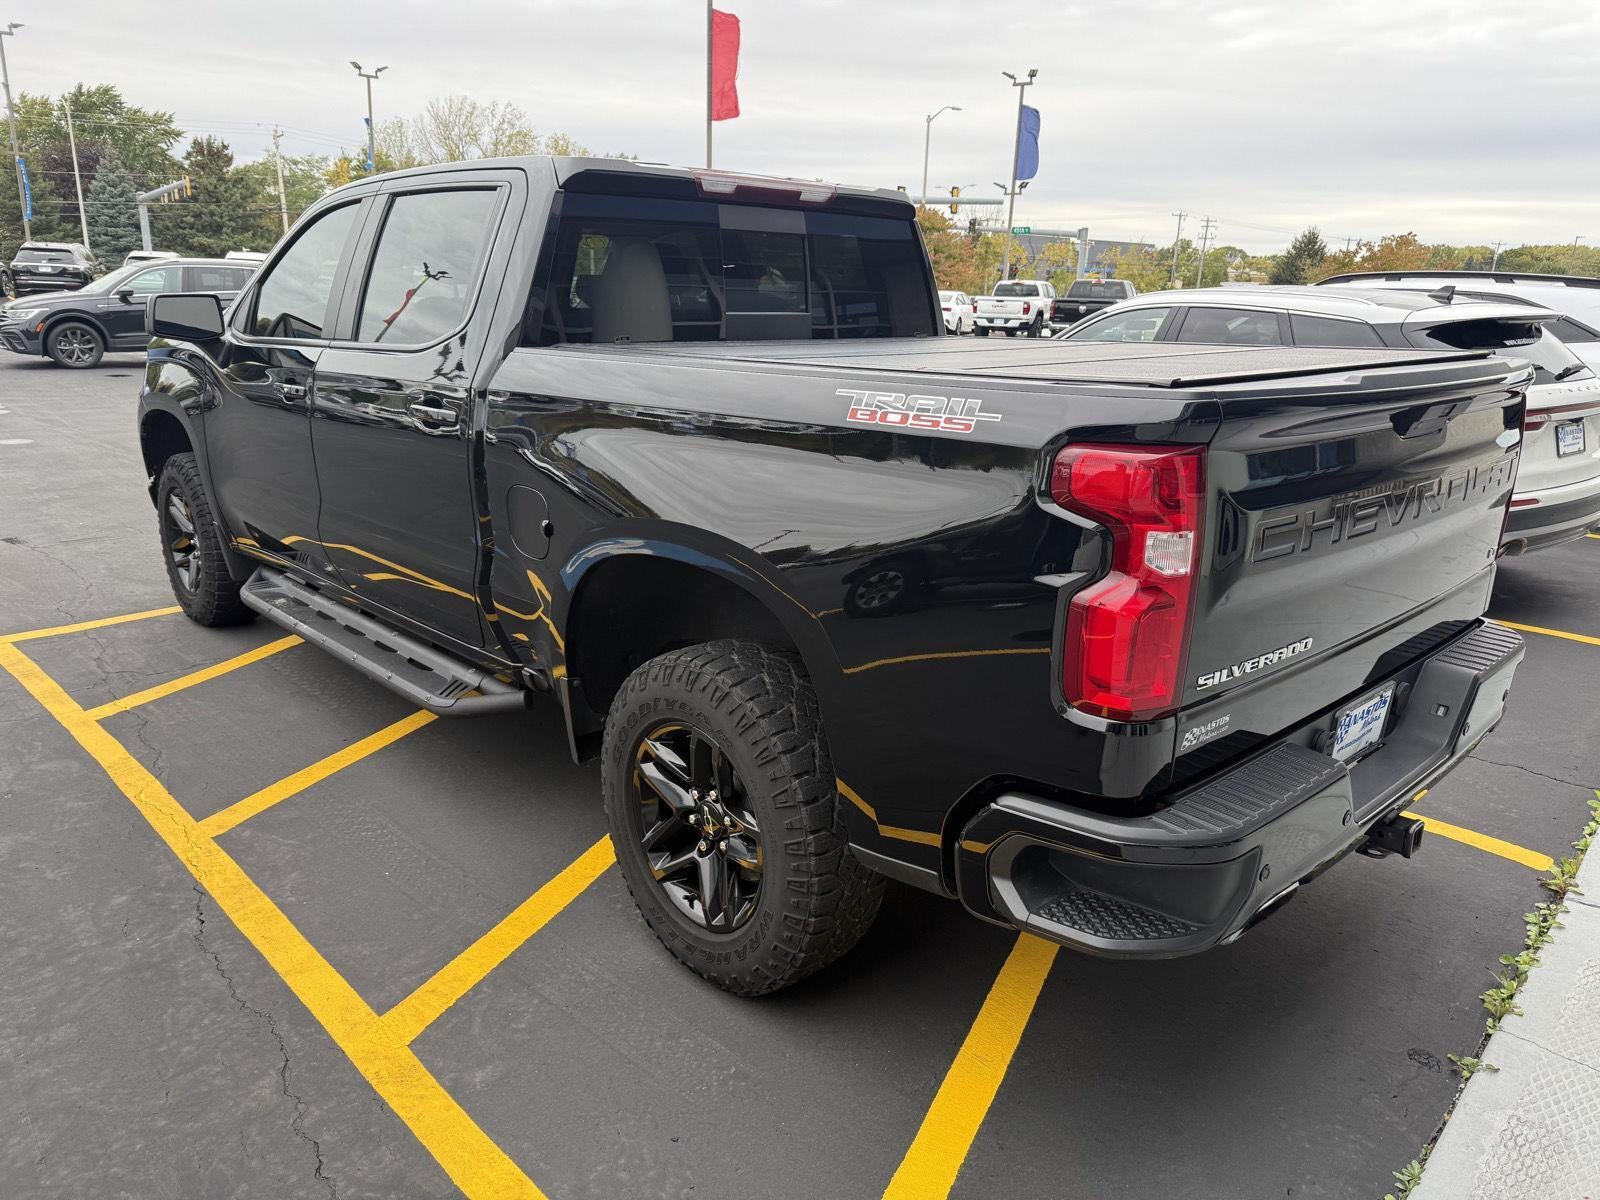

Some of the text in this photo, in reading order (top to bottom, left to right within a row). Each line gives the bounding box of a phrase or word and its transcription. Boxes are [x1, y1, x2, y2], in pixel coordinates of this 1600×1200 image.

[835, 388, 1002, 422] TRAIL
[847, 407, 976, 434] BOSS
[1251, 450, 1518, 563] CHEVROLET
[1196, 636, 1313, 691] SILVERADO
